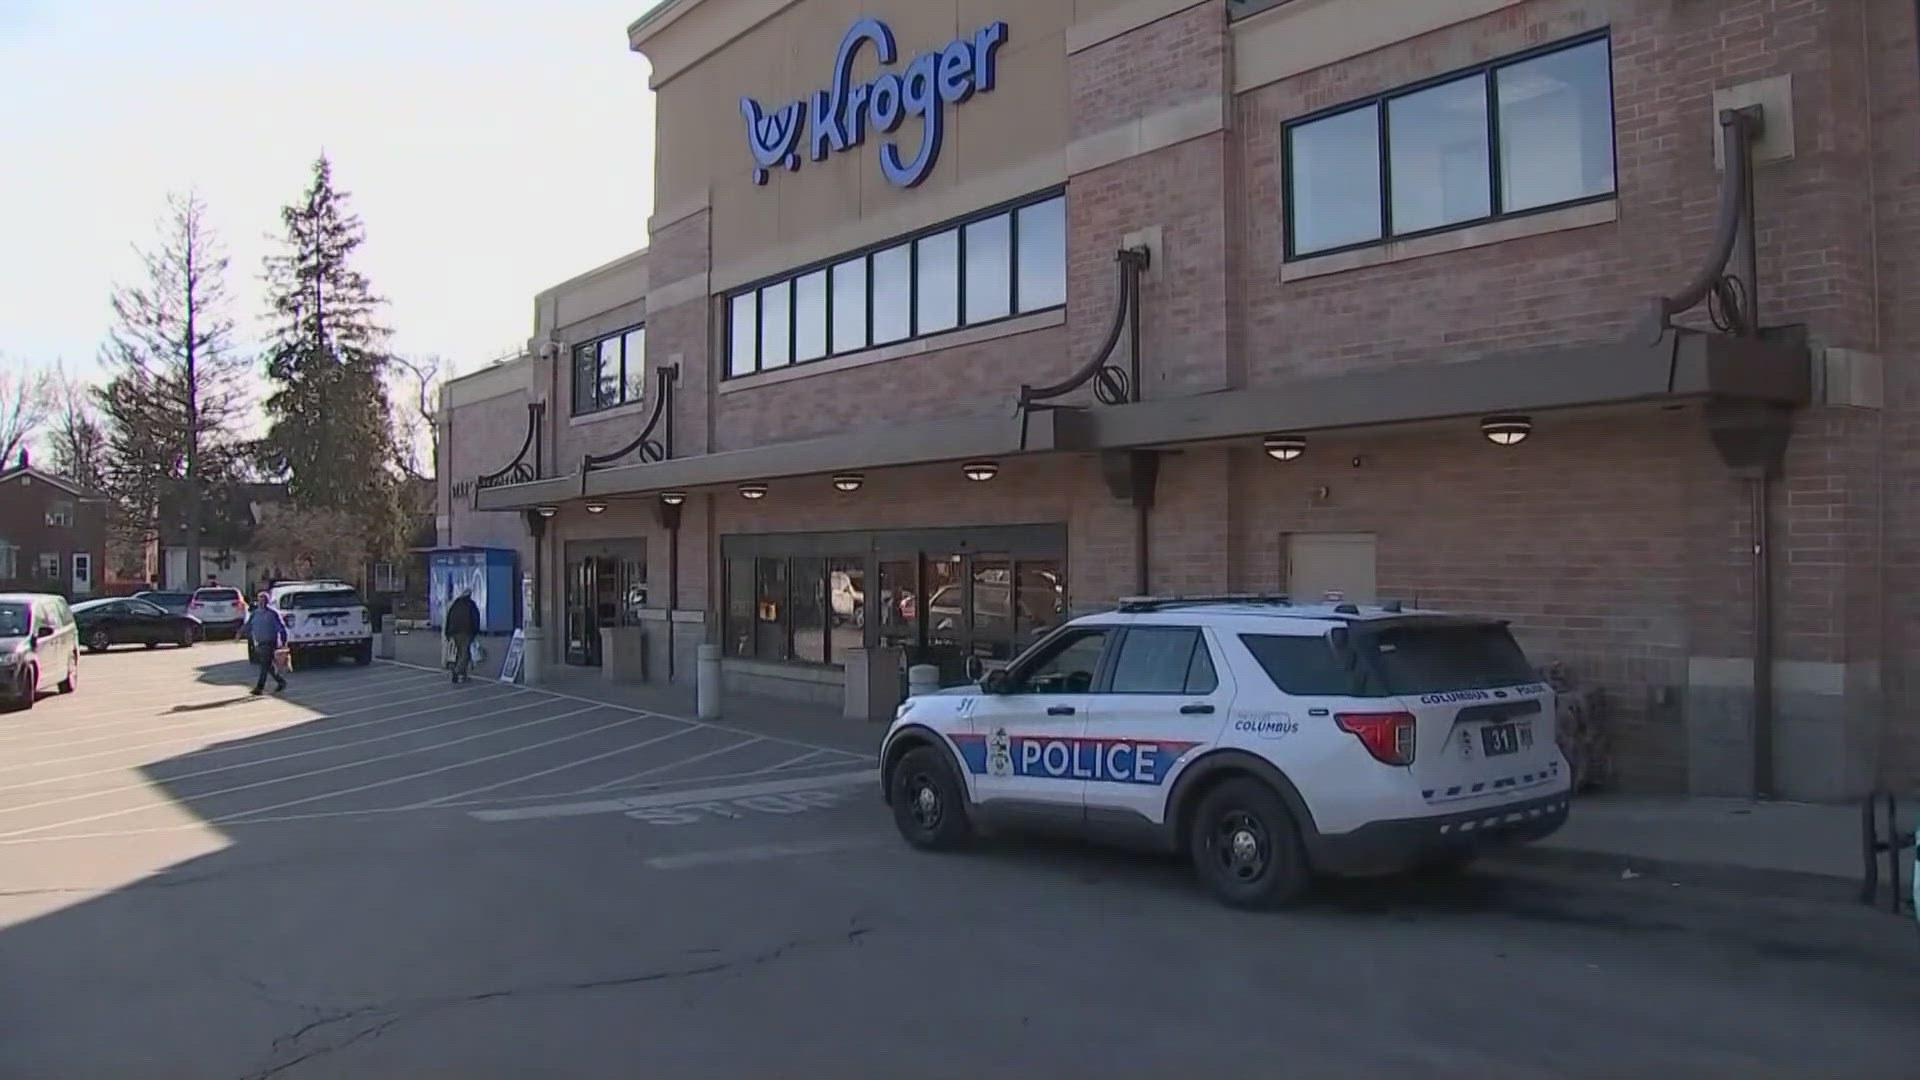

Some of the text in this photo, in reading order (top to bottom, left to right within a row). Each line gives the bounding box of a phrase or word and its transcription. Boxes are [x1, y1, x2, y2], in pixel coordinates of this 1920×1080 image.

[810, 18, 1008, 187] Kroger
[1420, 690, 1489, 704] COLUMBUS
[1234, 720, 1299, 734] COLUMBUS
[1490, 728, 1510, 751] 31
[1021, 739, 1158, 781] POLICE
